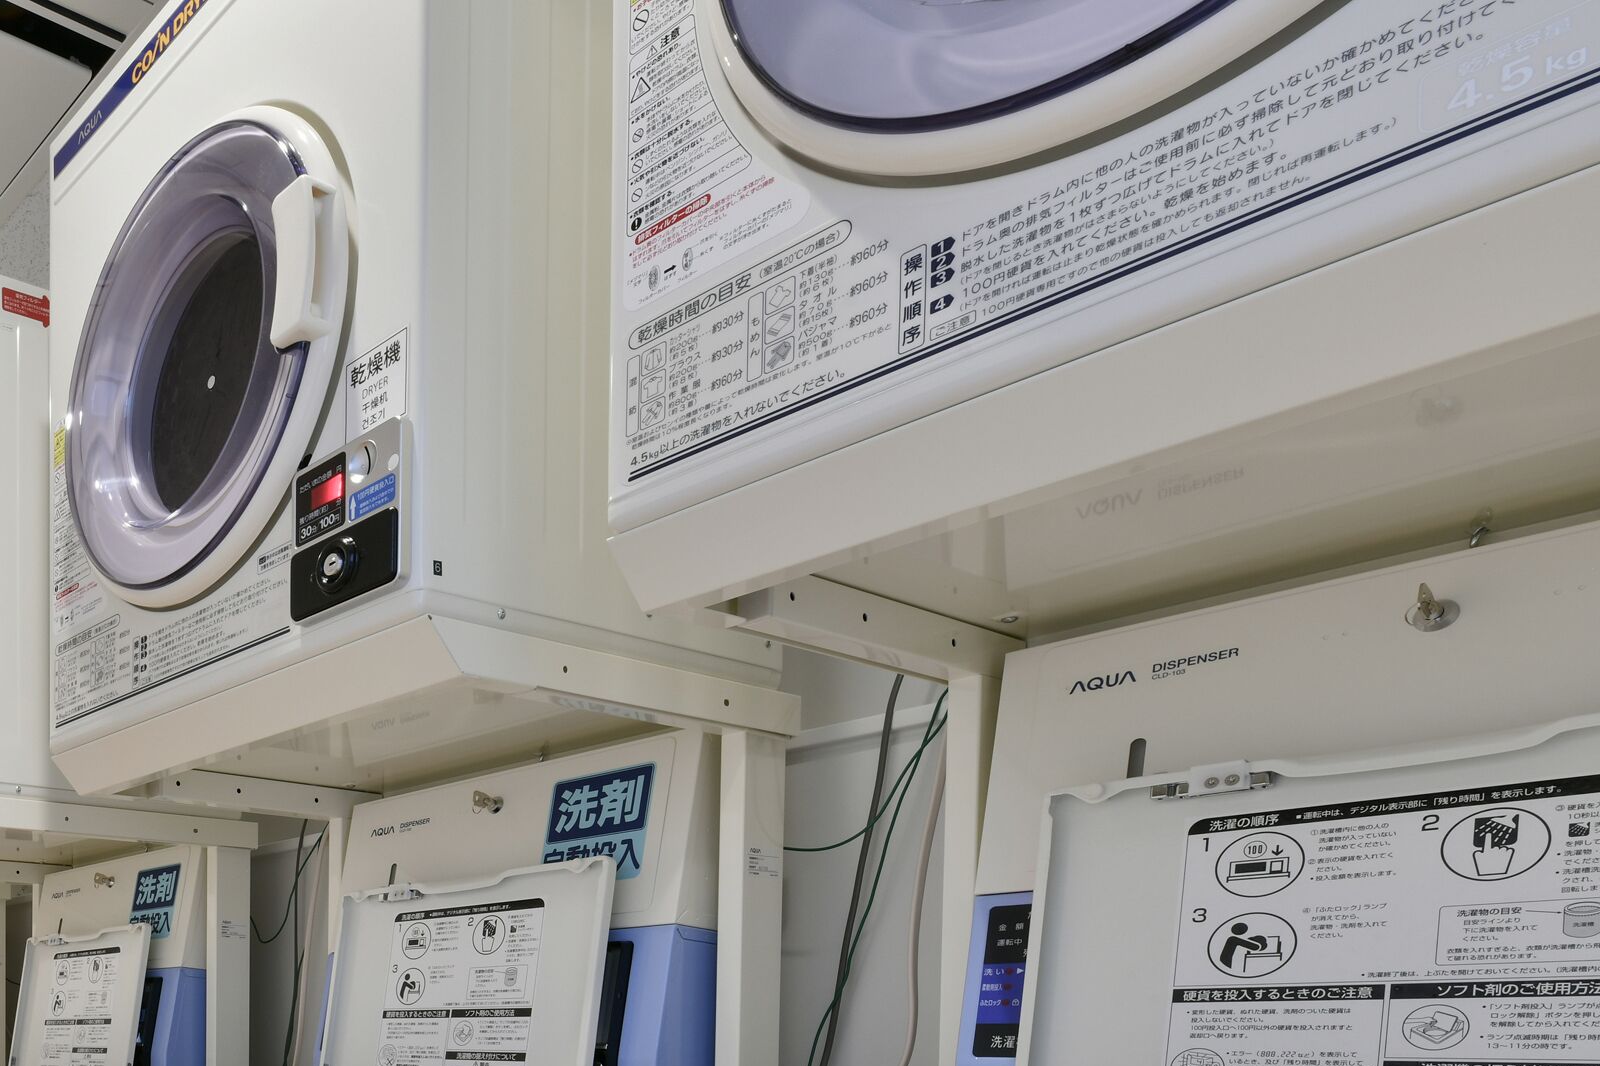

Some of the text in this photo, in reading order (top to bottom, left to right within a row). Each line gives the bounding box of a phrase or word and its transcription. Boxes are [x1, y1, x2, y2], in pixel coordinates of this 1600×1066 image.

[660, 27, 680, 48] 注意
[1447, 56, 1534, 111] 4.5
[1545, 47, 1588, 75] kg
[961, 0, 1515, 257] ドラム奥の排気フィルターはご使用前に必ず掃除して元どおり取り付けて
[637, 273, 752, 343] 乾燥時間の目安
[901, 253, 923, 346] 操作順序
[350, 340, 401, 388] 乾燥機
[362, 376, 389, 399] DRYER
[362, 408, 386, 430] 건조기
[1069, 647, 1240, 694] AQUA DISPENSER
[555, 775, 646, 833] 洗剤
[370, 826, 395, 838] AQUA
[1209, 813, 1280, 831] 洗濯の順序
[1421, 814, 1440, 832] 2
[1202, 837, 1210, 852] 1
[1247, 844, 1264, 855] 100
[136, 871, 177, 905] 洗剤
[1192, 908, 1207, 922] 3
[1183, 986, 1374, 1002] 硬貨を投入するときのご注意
[990, 1035, 1019, 1049] 洗濯
